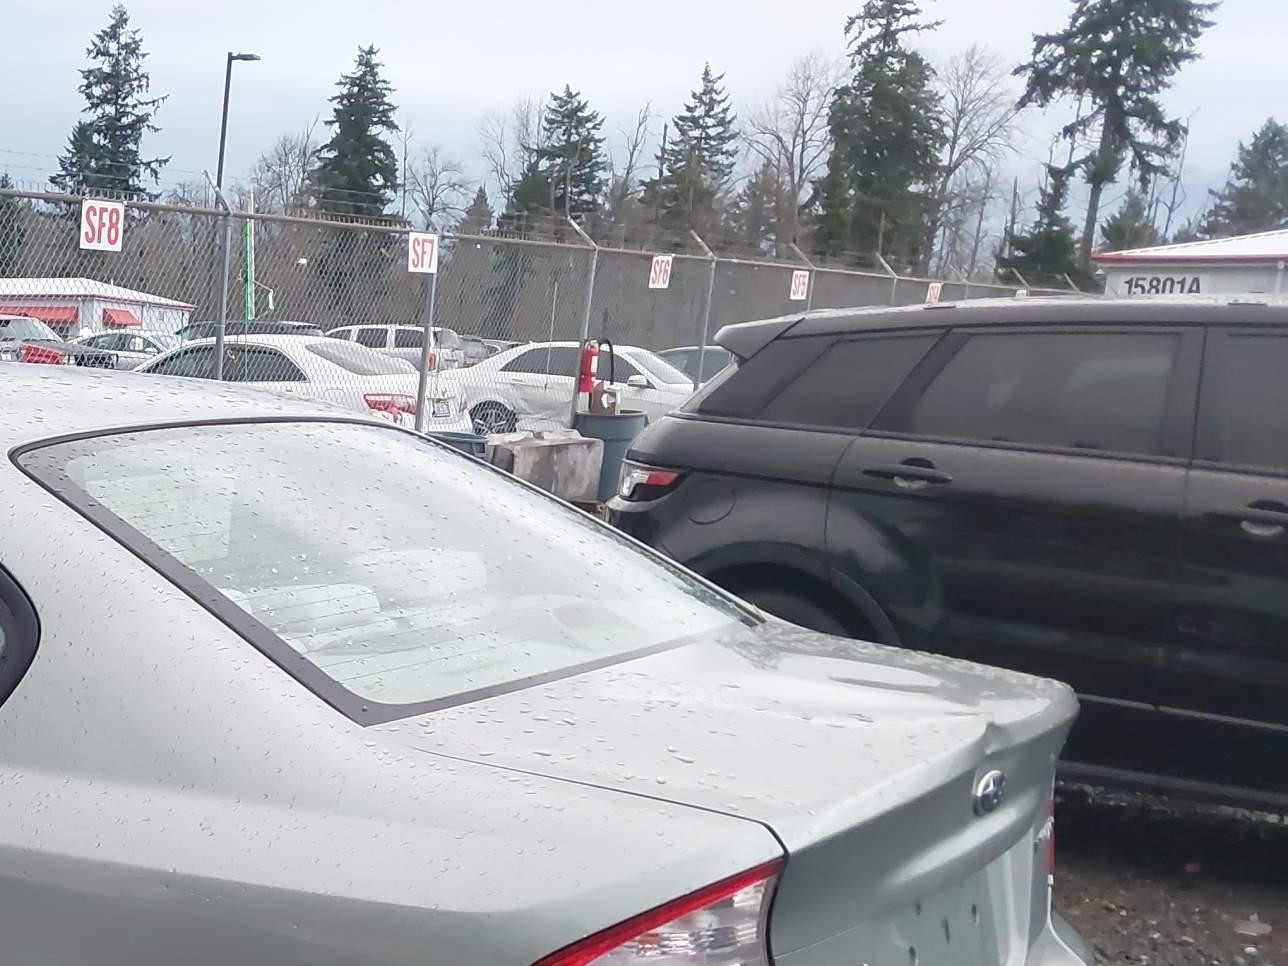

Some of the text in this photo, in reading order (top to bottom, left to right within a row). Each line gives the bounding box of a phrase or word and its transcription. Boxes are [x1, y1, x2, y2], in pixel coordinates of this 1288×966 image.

[84, 205, 120, 245] SF8
[412, 237, 434, 268] SF7
[652, 259, 670, 284] SF6
[1123, 276, 1201, 294] 15801A
